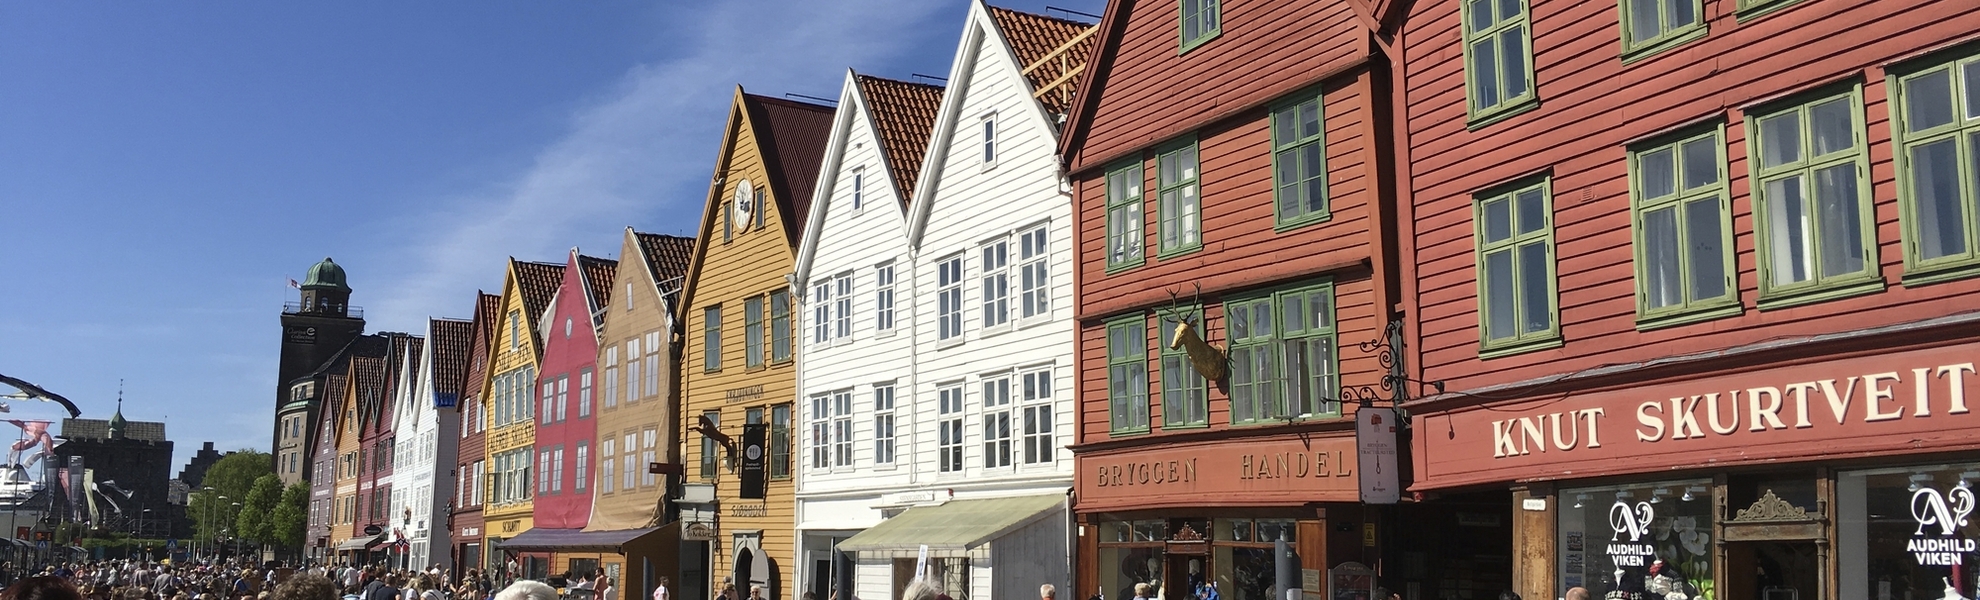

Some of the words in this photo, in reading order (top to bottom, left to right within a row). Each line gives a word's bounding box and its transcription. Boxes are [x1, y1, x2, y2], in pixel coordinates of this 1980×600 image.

[1491, 407, 1605, 458] KNUT
[1635, 362, 1976, 442] SKURTVEIT
[1097, 457, 1197, 488] BRYGGEN
[1240, 450, 1352, 480] HANDEL
[1606, 543, 1654, 556] AUDHILD
[1906, 538, 1976, 552] AUDHILD
[1611, 555, 1645, 567] VIKEN
[1915, 552, 1963, 566] VIKEN
